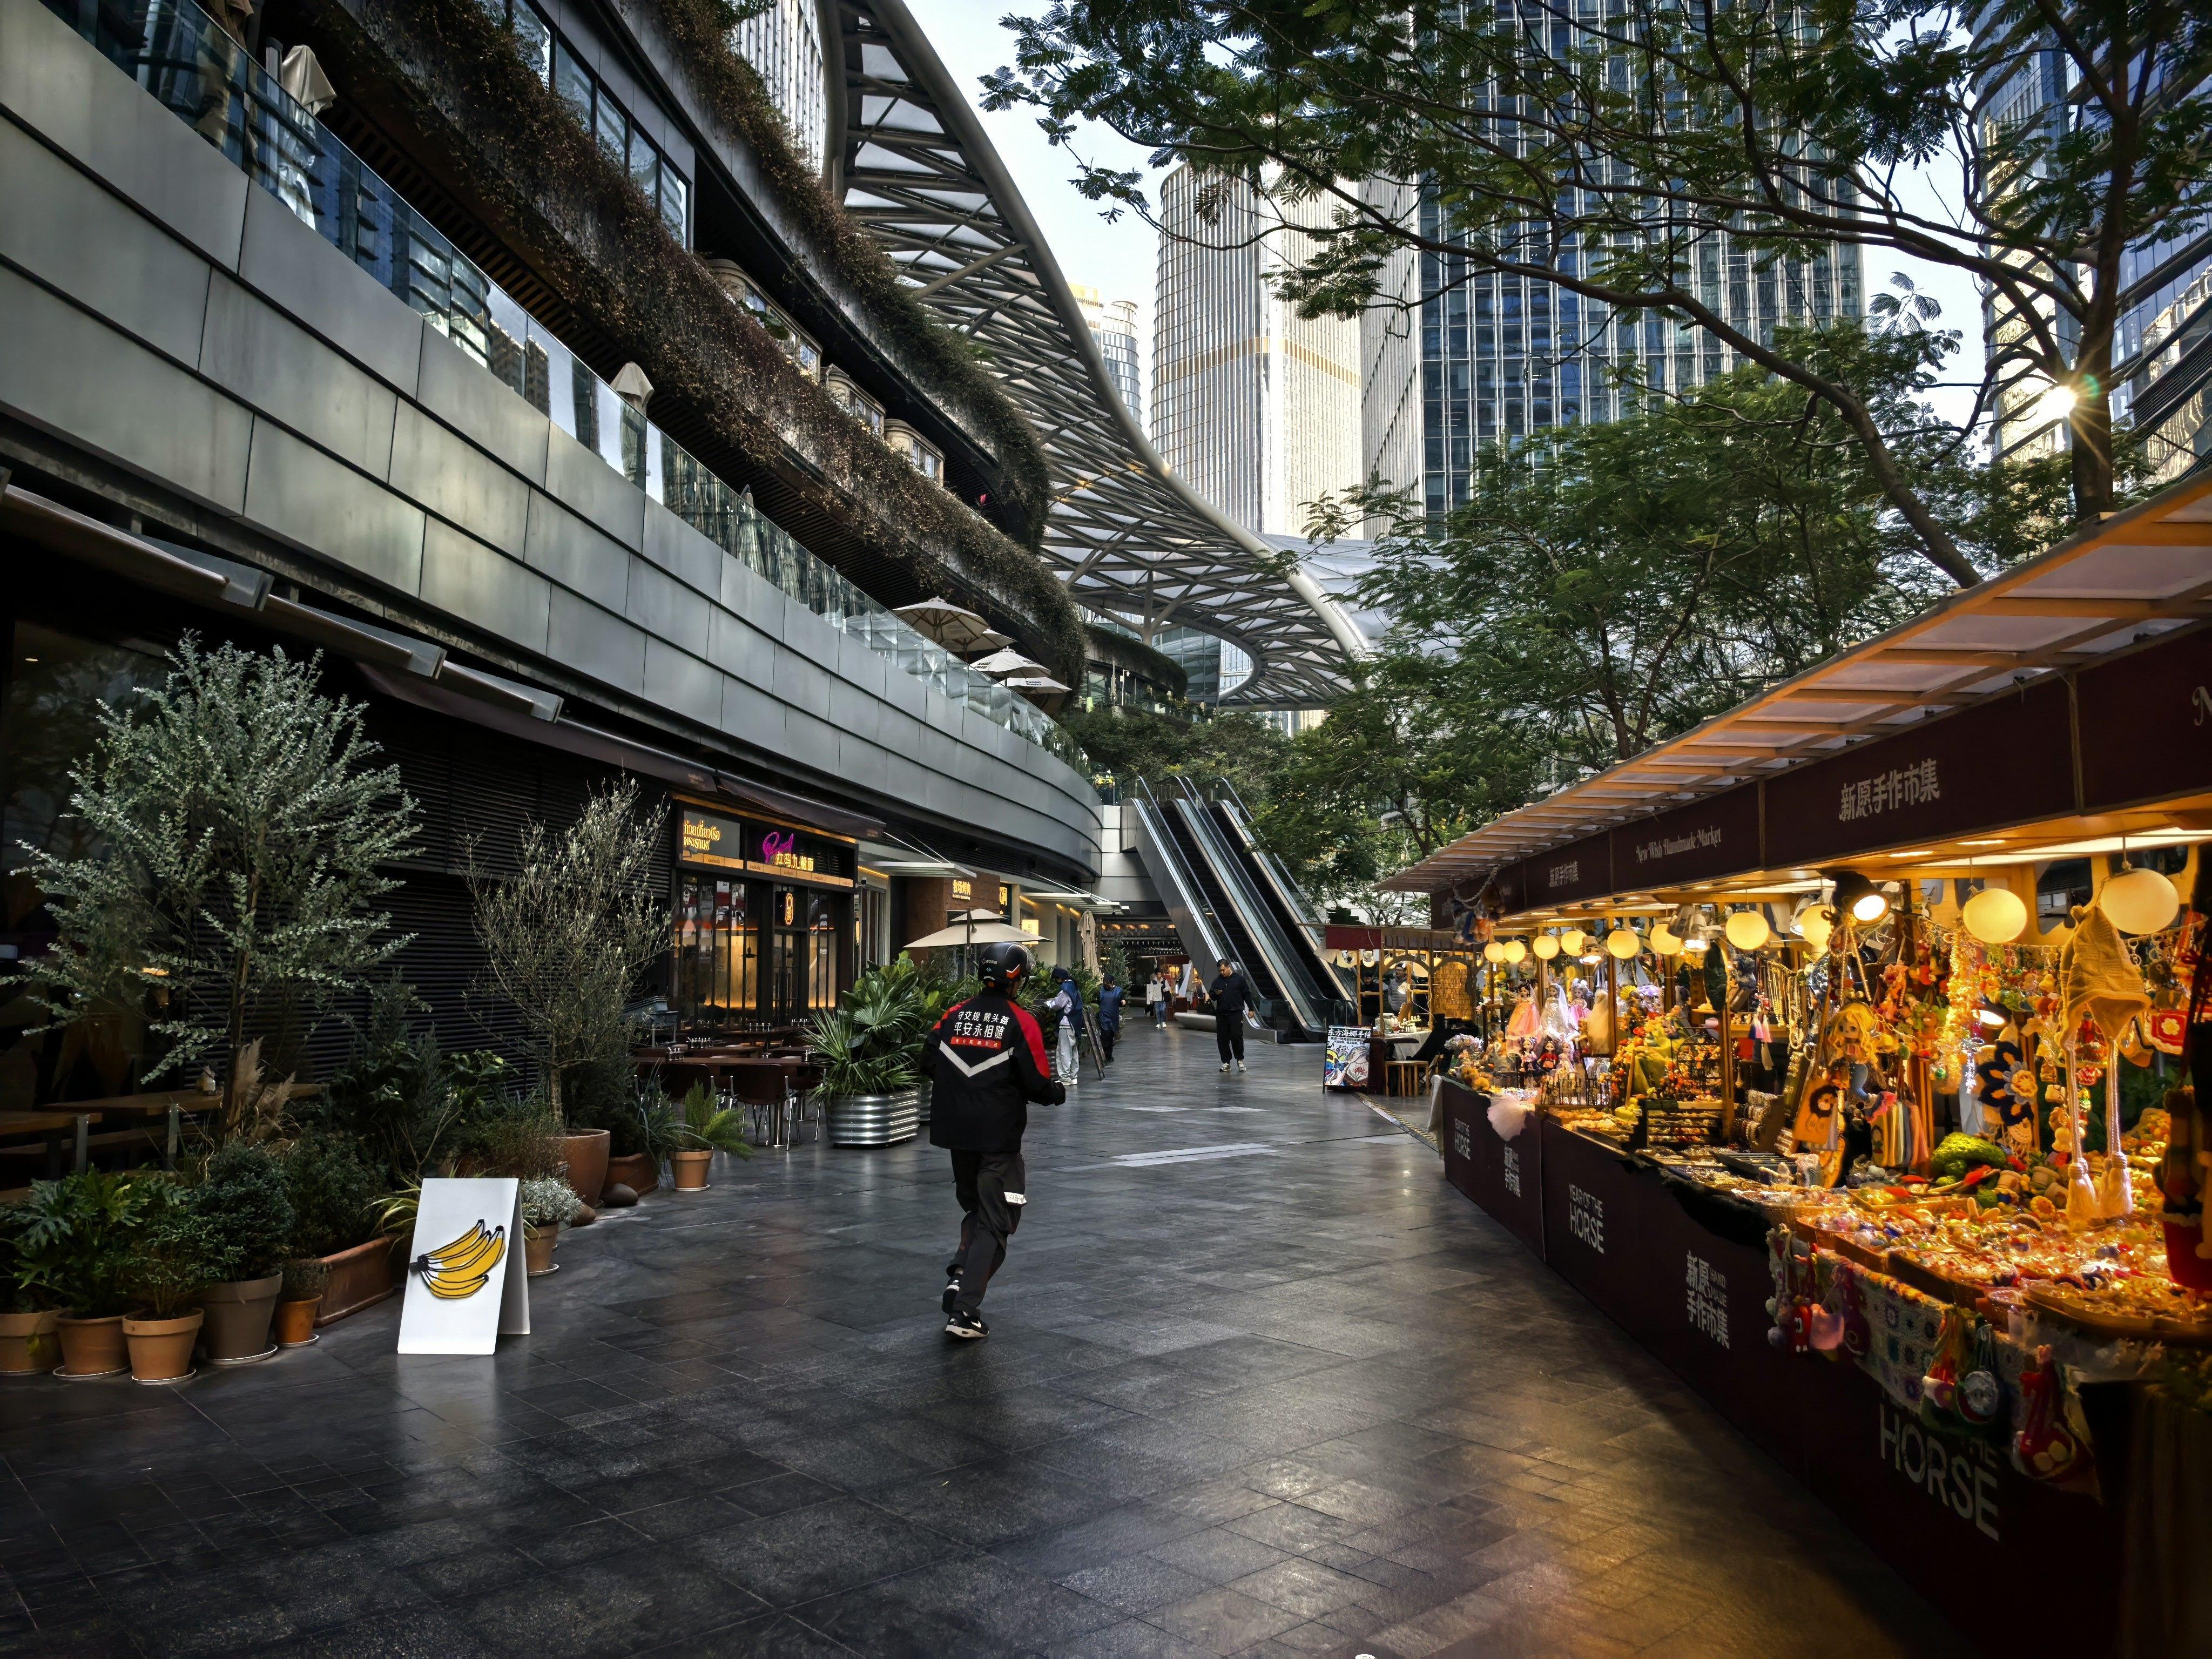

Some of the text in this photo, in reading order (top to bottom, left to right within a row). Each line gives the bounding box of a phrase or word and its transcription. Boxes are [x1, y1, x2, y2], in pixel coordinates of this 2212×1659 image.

[1838, 758, 1940, 822] 新愿手作市集
[954, 1022, 1005, 1039] 平安永相随
[958, 1011, 1010, 1025] 守交规 戴头盔
[1569, 1183, 1583, 1204] YEAR
[1591, 1196, 1603, 1218] THE
[1570, 1202, 1604, 1254] HORSE
[1685, 1250, 1711, 1299] 新愿
[1687, 1289, 1730, 1350] 手作市集
[1879, 1403, 1999, 1542] HORSE
